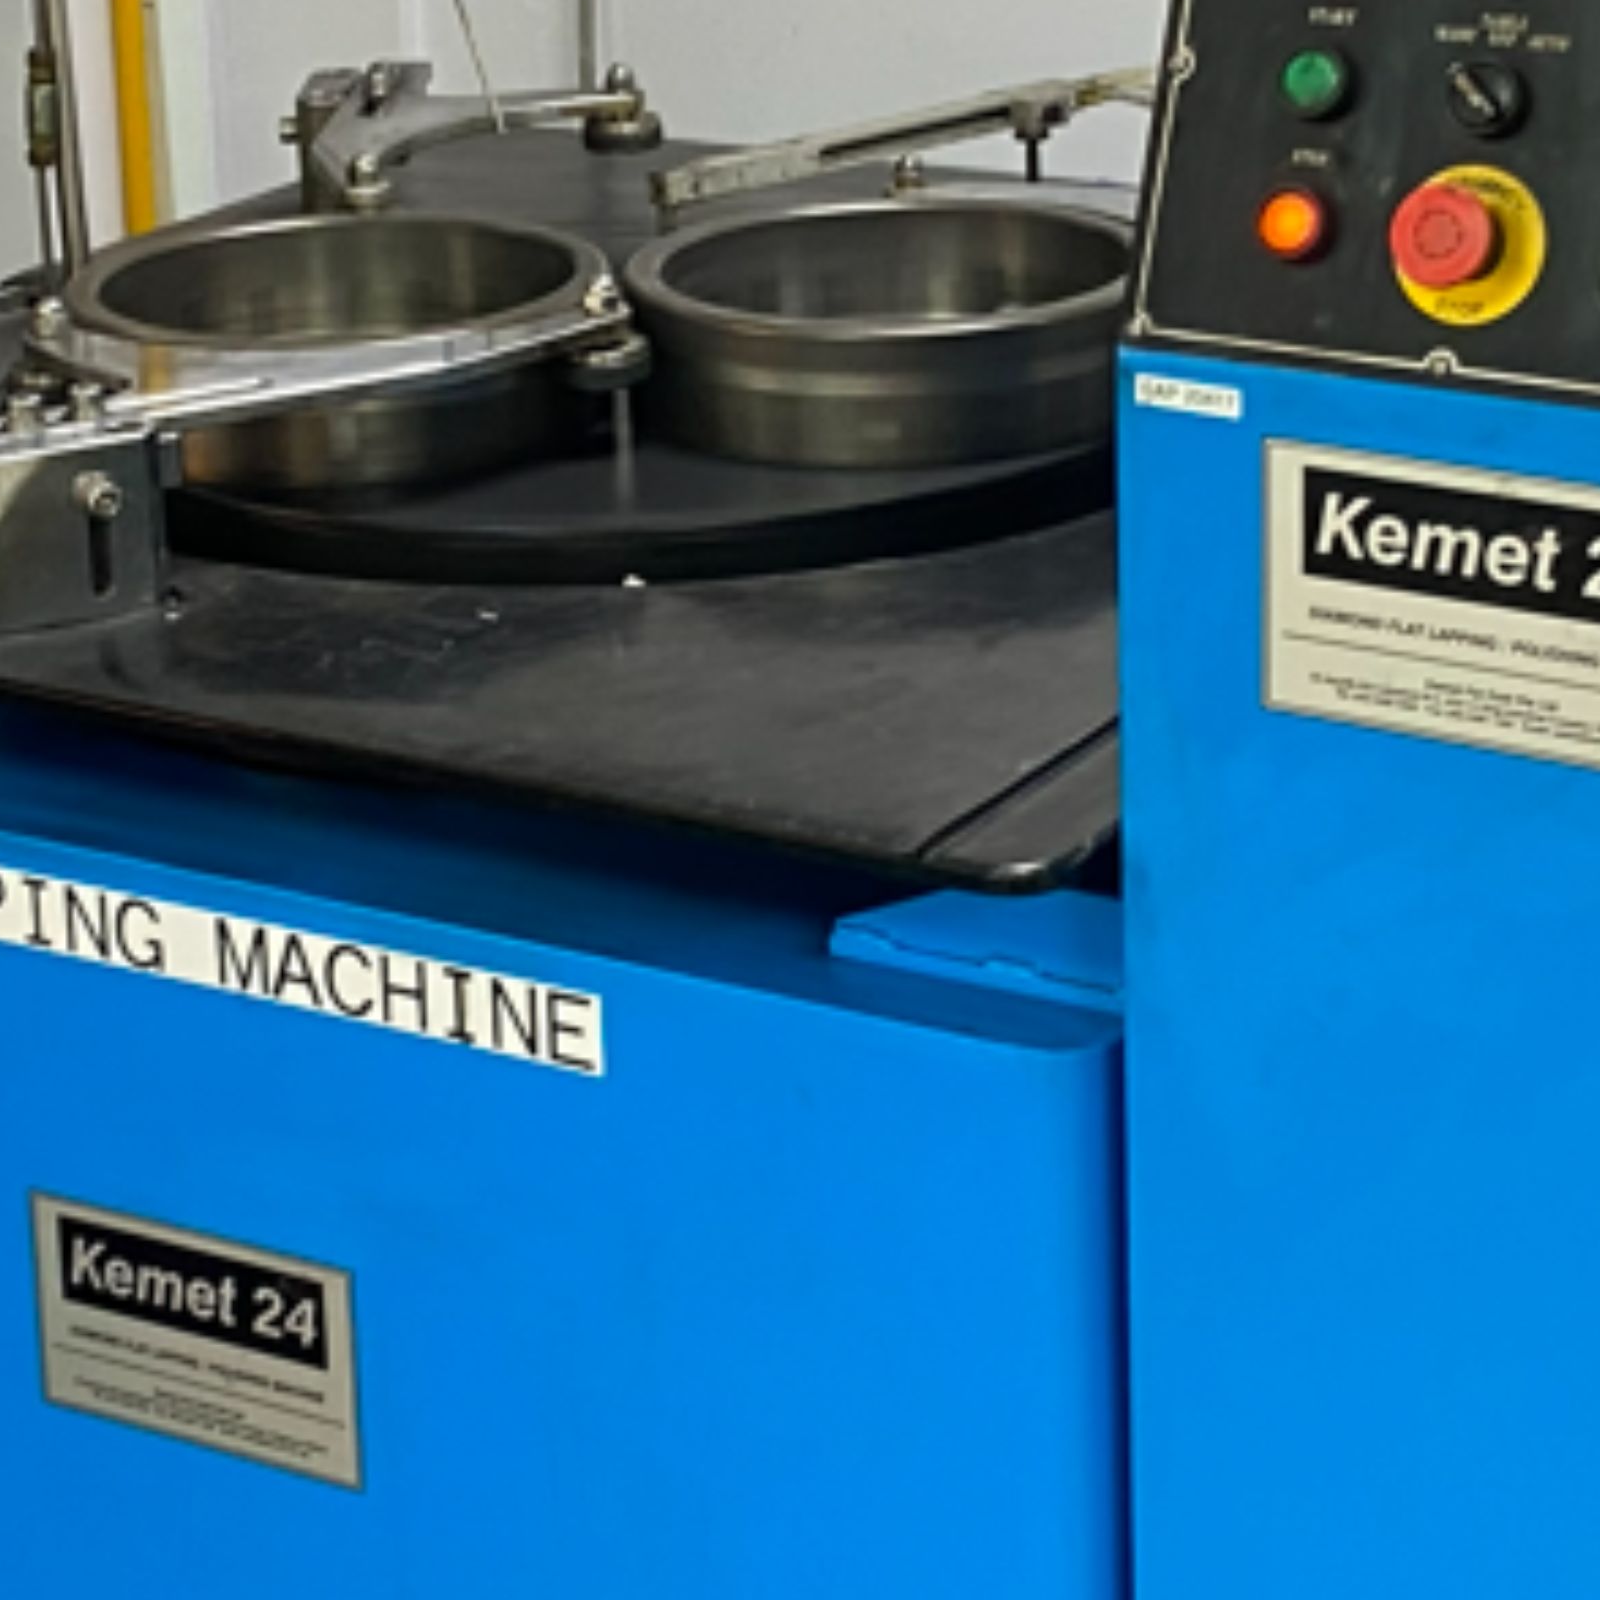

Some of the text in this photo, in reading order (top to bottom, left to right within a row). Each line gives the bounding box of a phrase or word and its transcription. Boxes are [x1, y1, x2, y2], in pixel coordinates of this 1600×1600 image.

[1314, 490, 1562, 593] Kemet
[214, 916, 599, 1073] MACHINE
[70, 1236, 318, 1349] Kemet 24
